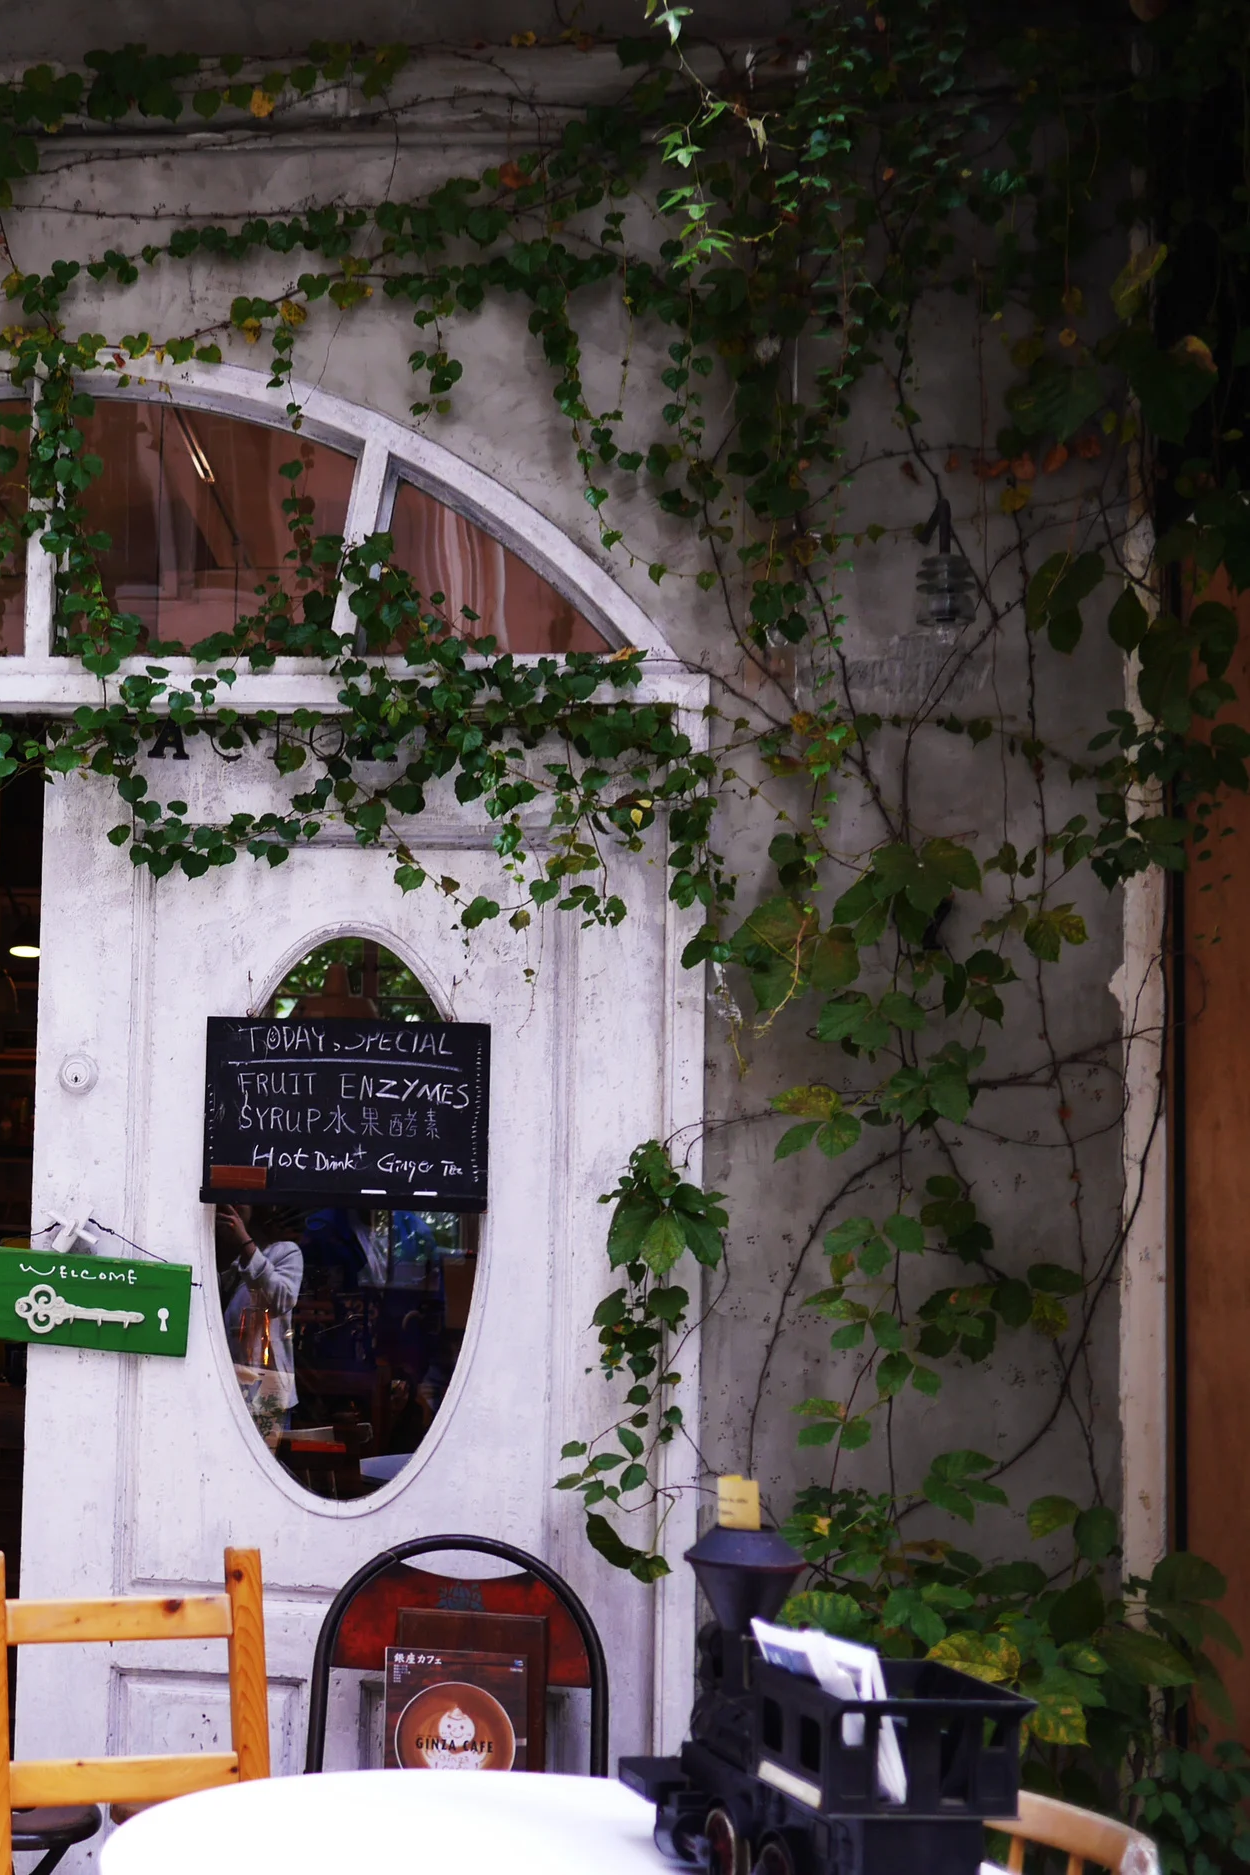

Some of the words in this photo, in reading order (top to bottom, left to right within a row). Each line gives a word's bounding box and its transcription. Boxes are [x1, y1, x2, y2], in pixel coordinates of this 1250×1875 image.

[238, 1072, 318, 1097] FRUIT
[339, 1073, 469, 1109] ENZYMES
[239, 1104, 321, 1133] SYRUP
[323, 1104, 440, 1140] 水果酵素
[252, 1144, 309, 1170] Hot
[19, 1263, 137, 1285] WELCOME
[394, 1652, 442, 1665] 銀座カフェ
[415, 1736, 456, 1751] GINZA
[463, 1739, 493, 1753] CAFE
